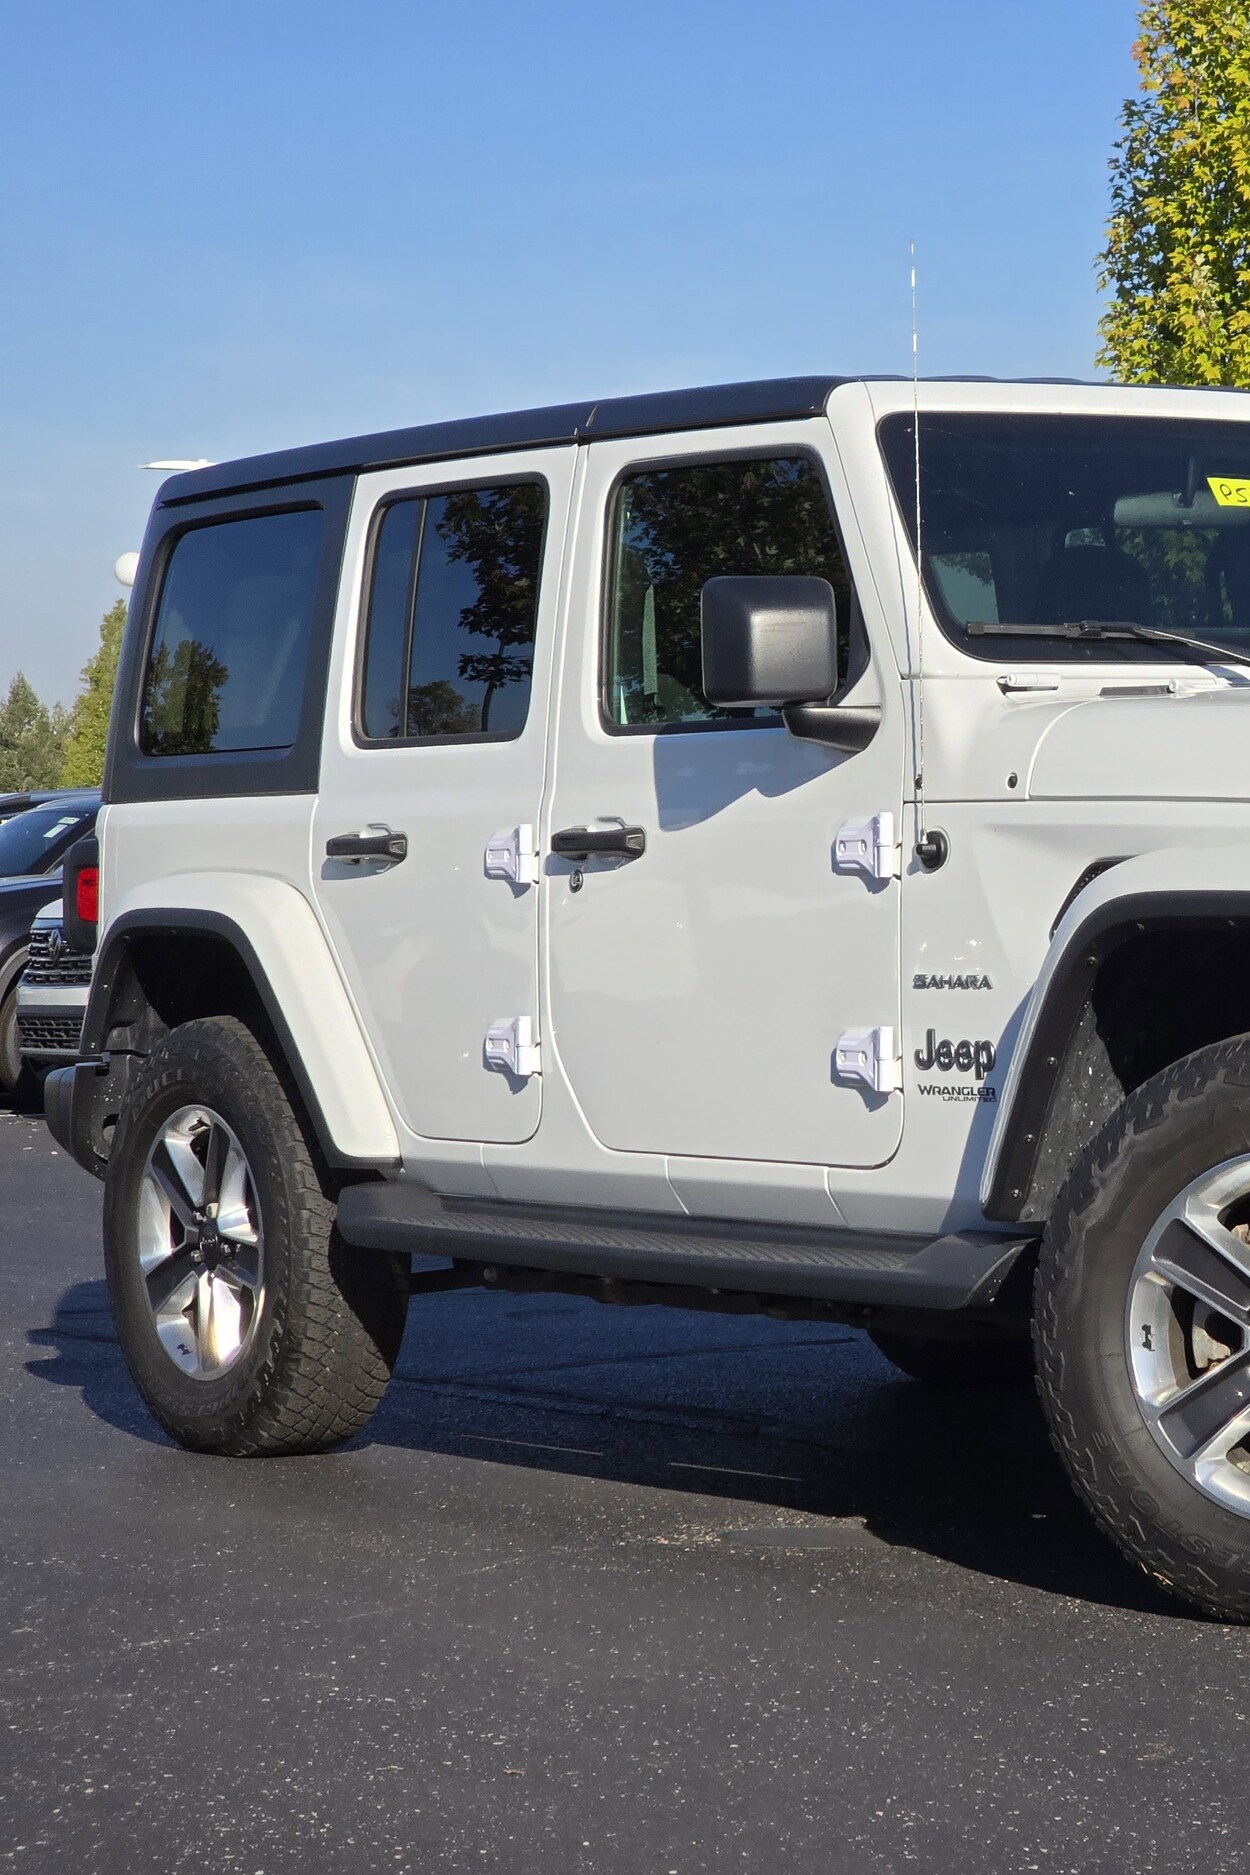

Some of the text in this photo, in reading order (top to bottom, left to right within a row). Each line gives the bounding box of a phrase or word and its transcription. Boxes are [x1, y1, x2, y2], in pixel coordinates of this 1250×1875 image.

[912, 974, 994, 990] SAHARA
[914, 1028, 996, 1081] Jeep
[917, 1084, 996, 1097] WRANGLER
